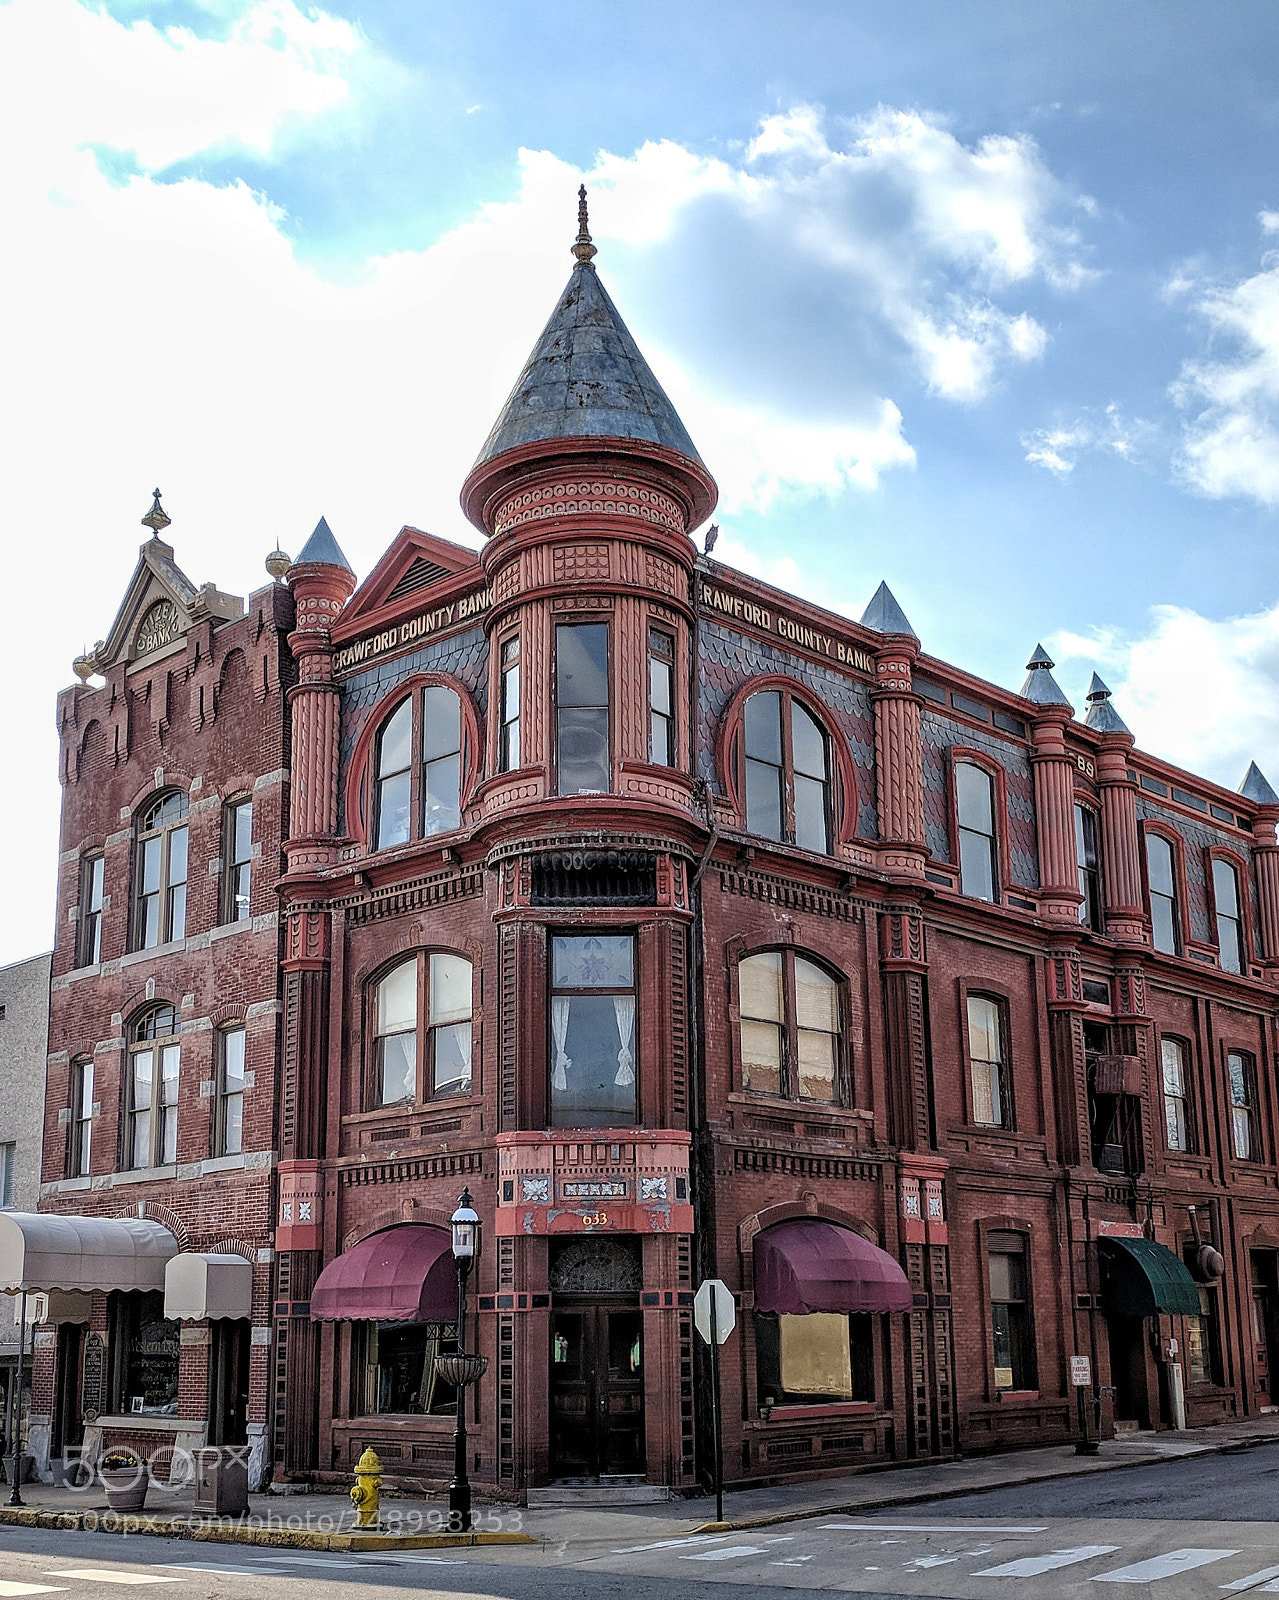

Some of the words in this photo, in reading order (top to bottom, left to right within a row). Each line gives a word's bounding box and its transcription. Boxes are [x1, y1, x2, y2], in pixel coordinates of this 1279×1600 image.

[147, 628, 171, 652] BANK
[332, 627, 397, 670] CRAWFORD
[401, 603, 455, 642] COUNTY
[459, 587, 494, 619] BANK
[777, 616, 832, 655] COUNTY
[837, 642, 872, 673] BANK
[582, 1212, 608, 1225] 633
